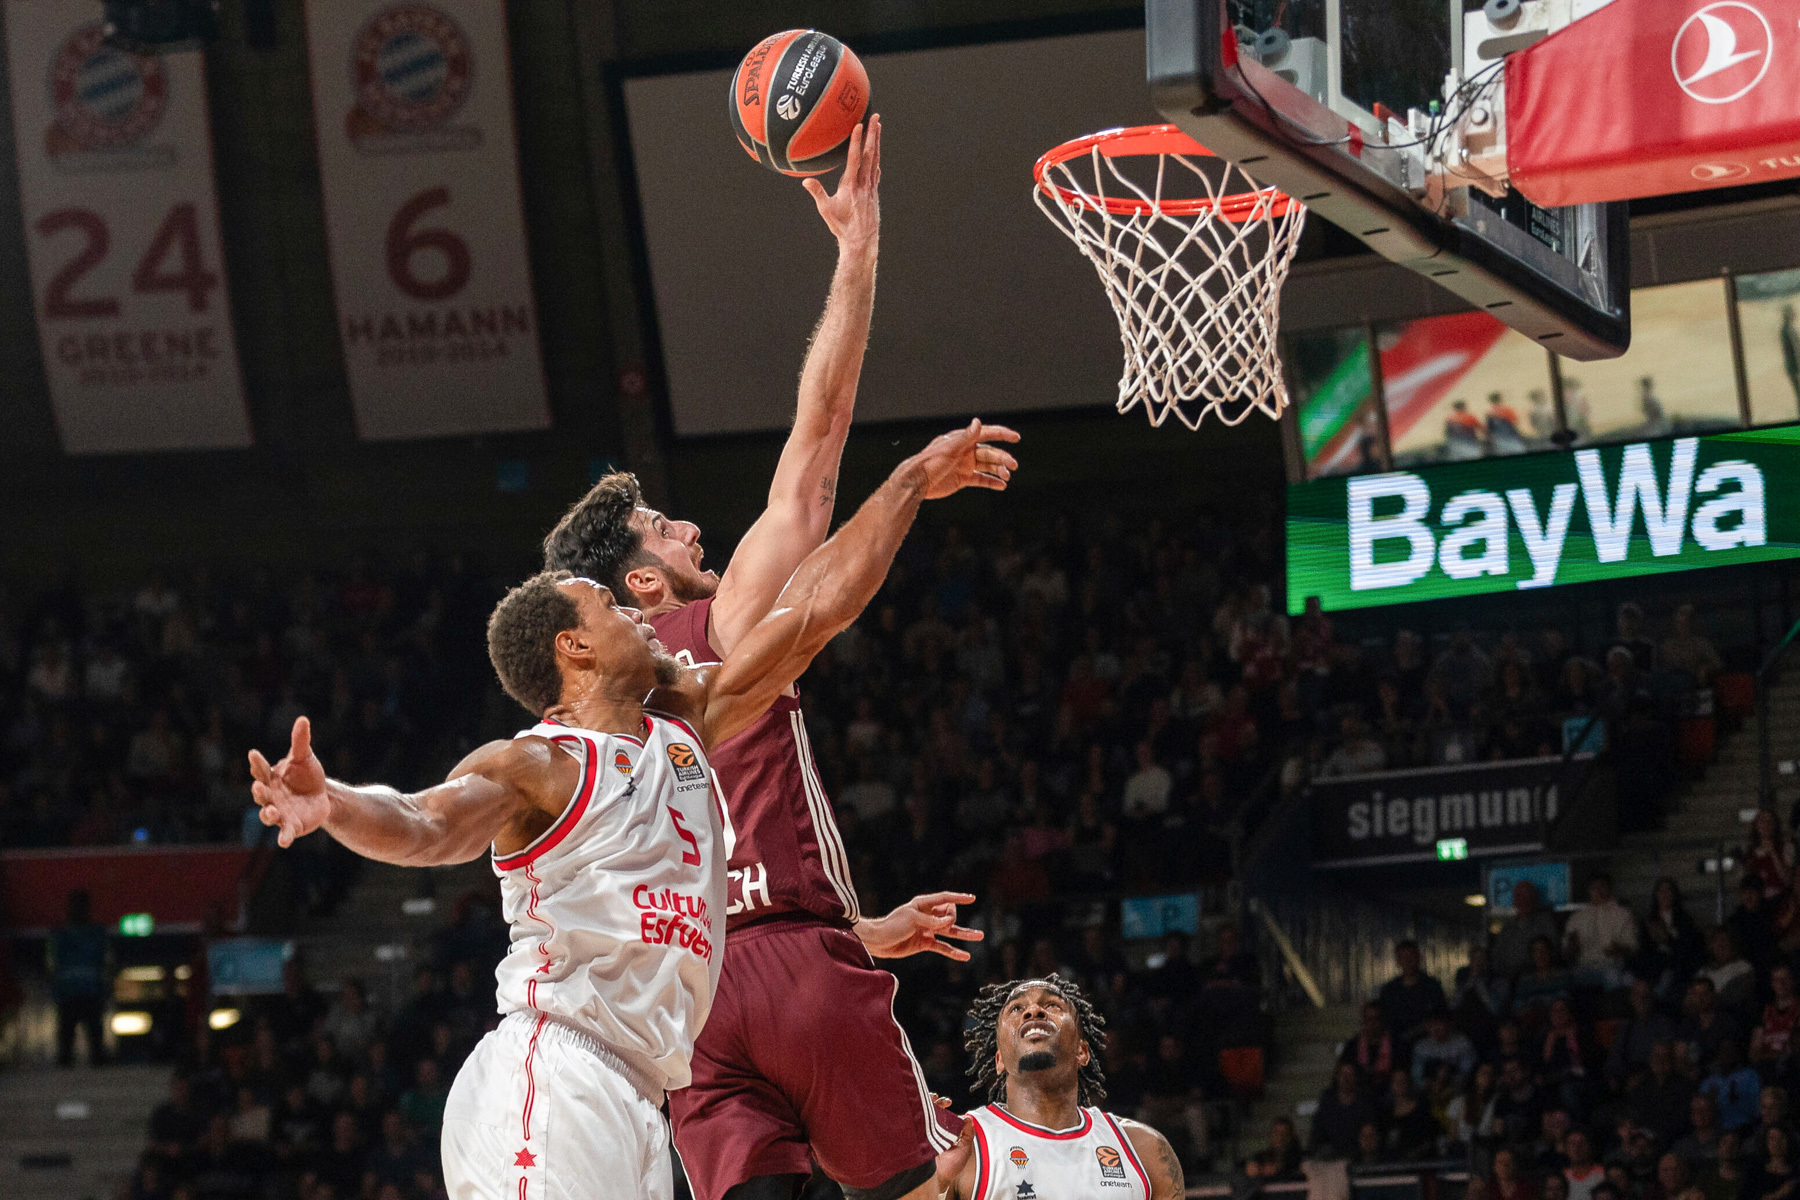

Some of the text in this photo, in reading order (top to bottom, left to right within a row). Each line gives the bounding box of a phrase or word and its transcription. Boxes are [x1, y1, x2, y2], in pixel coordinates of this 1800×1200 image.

[787, 53, 811, 91] TURKISH
[35, 201, 219, 319] 24
[385, 185, 472, 300] 6
[57, 326, 221, 367] GREENE
[347, 305, 530, 342] HAMANN
[1346, 437, 1767, 591] BayWa
[666, 804, 701, 867] 5
[1100, 1179, 1133, 1189] oneteam
